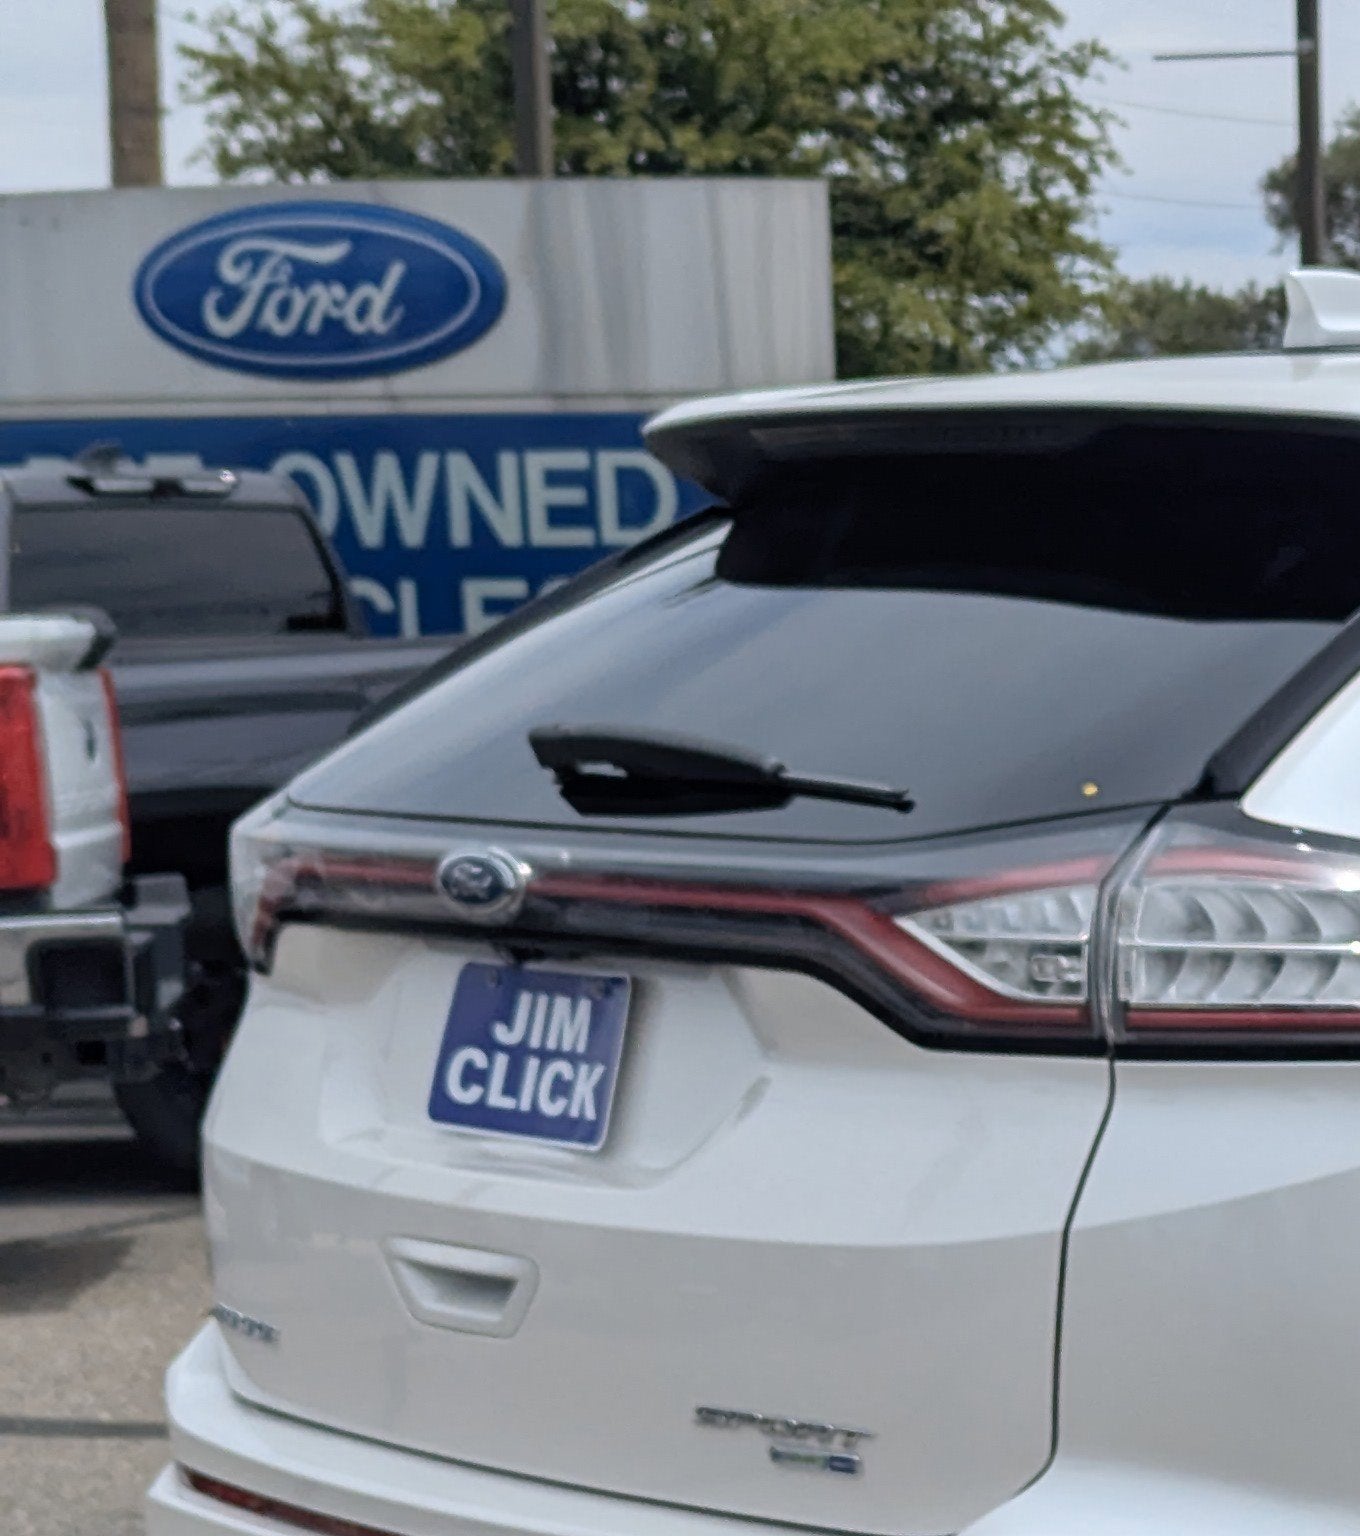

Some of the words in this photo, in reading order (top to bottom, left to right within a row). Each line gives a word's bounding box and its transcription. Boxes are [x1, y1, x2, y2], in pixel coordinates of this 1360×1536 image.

[203, 237, 405, 337] Ford
[492, 991, 592, 1053] JIM
[446, 1047, 606, 1121] CLICK
